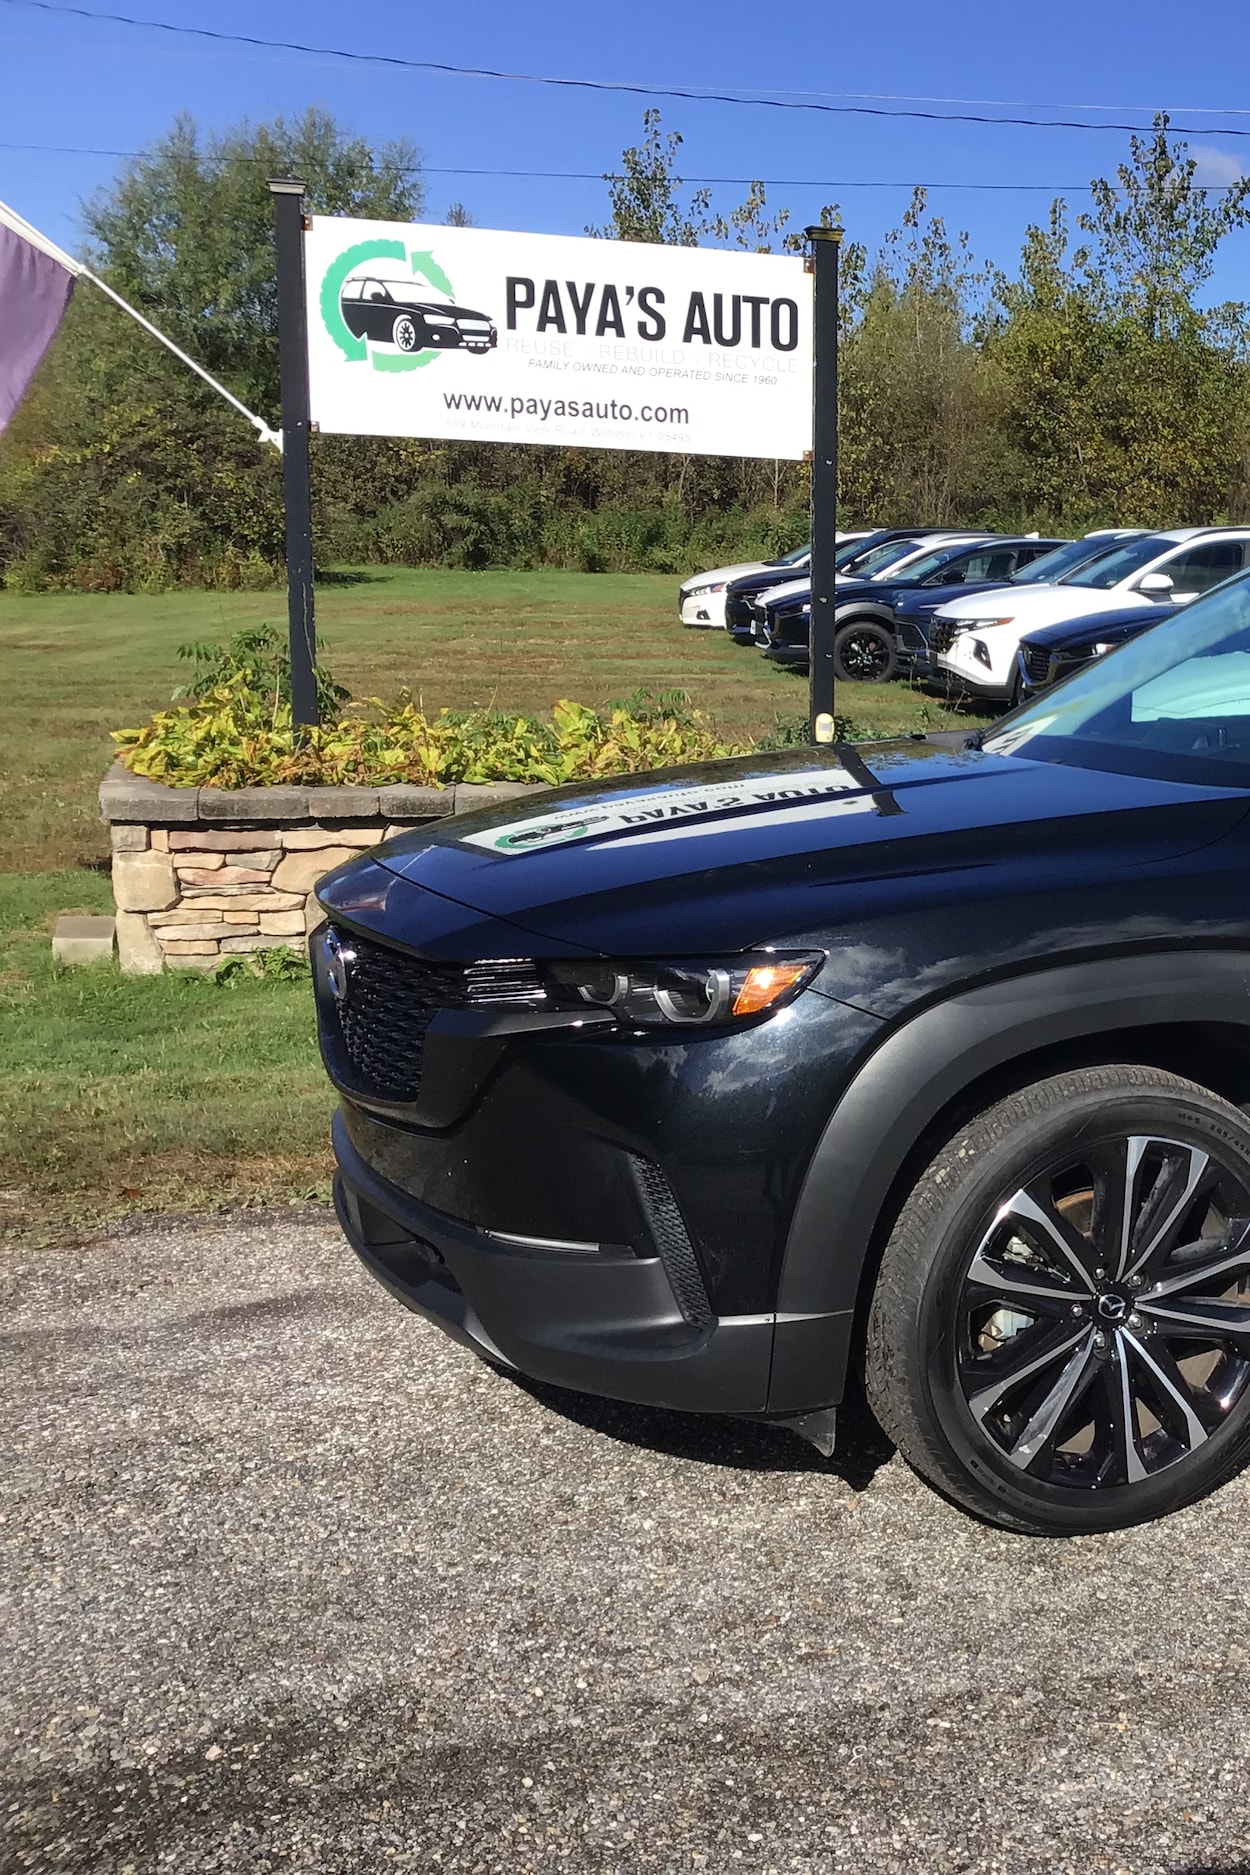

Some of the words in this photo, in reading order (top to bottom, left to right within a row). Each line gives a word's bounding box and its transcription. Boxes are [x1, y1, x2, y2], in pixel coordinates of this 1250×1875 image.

[505, 275, 666, 342] PAYA'S
[682, 292, 799, 352] AUTO
[506, 337, 574, 357] REUSE
[599, 343, 685, 364] REBUILD
[709, 352, 798, 373] RECYCLE
[527, 358, 570, 371] FAMILY
[572, 361, 618, 374] OWNED
[620, 365, 646, 377] AND
[649, 367, 712, 381] OPERATED
[714, 371, 749, 384] SINCE
[753, 375, 778, 386] 1960
[442, 392, 689, 425] www.payasauto.com
